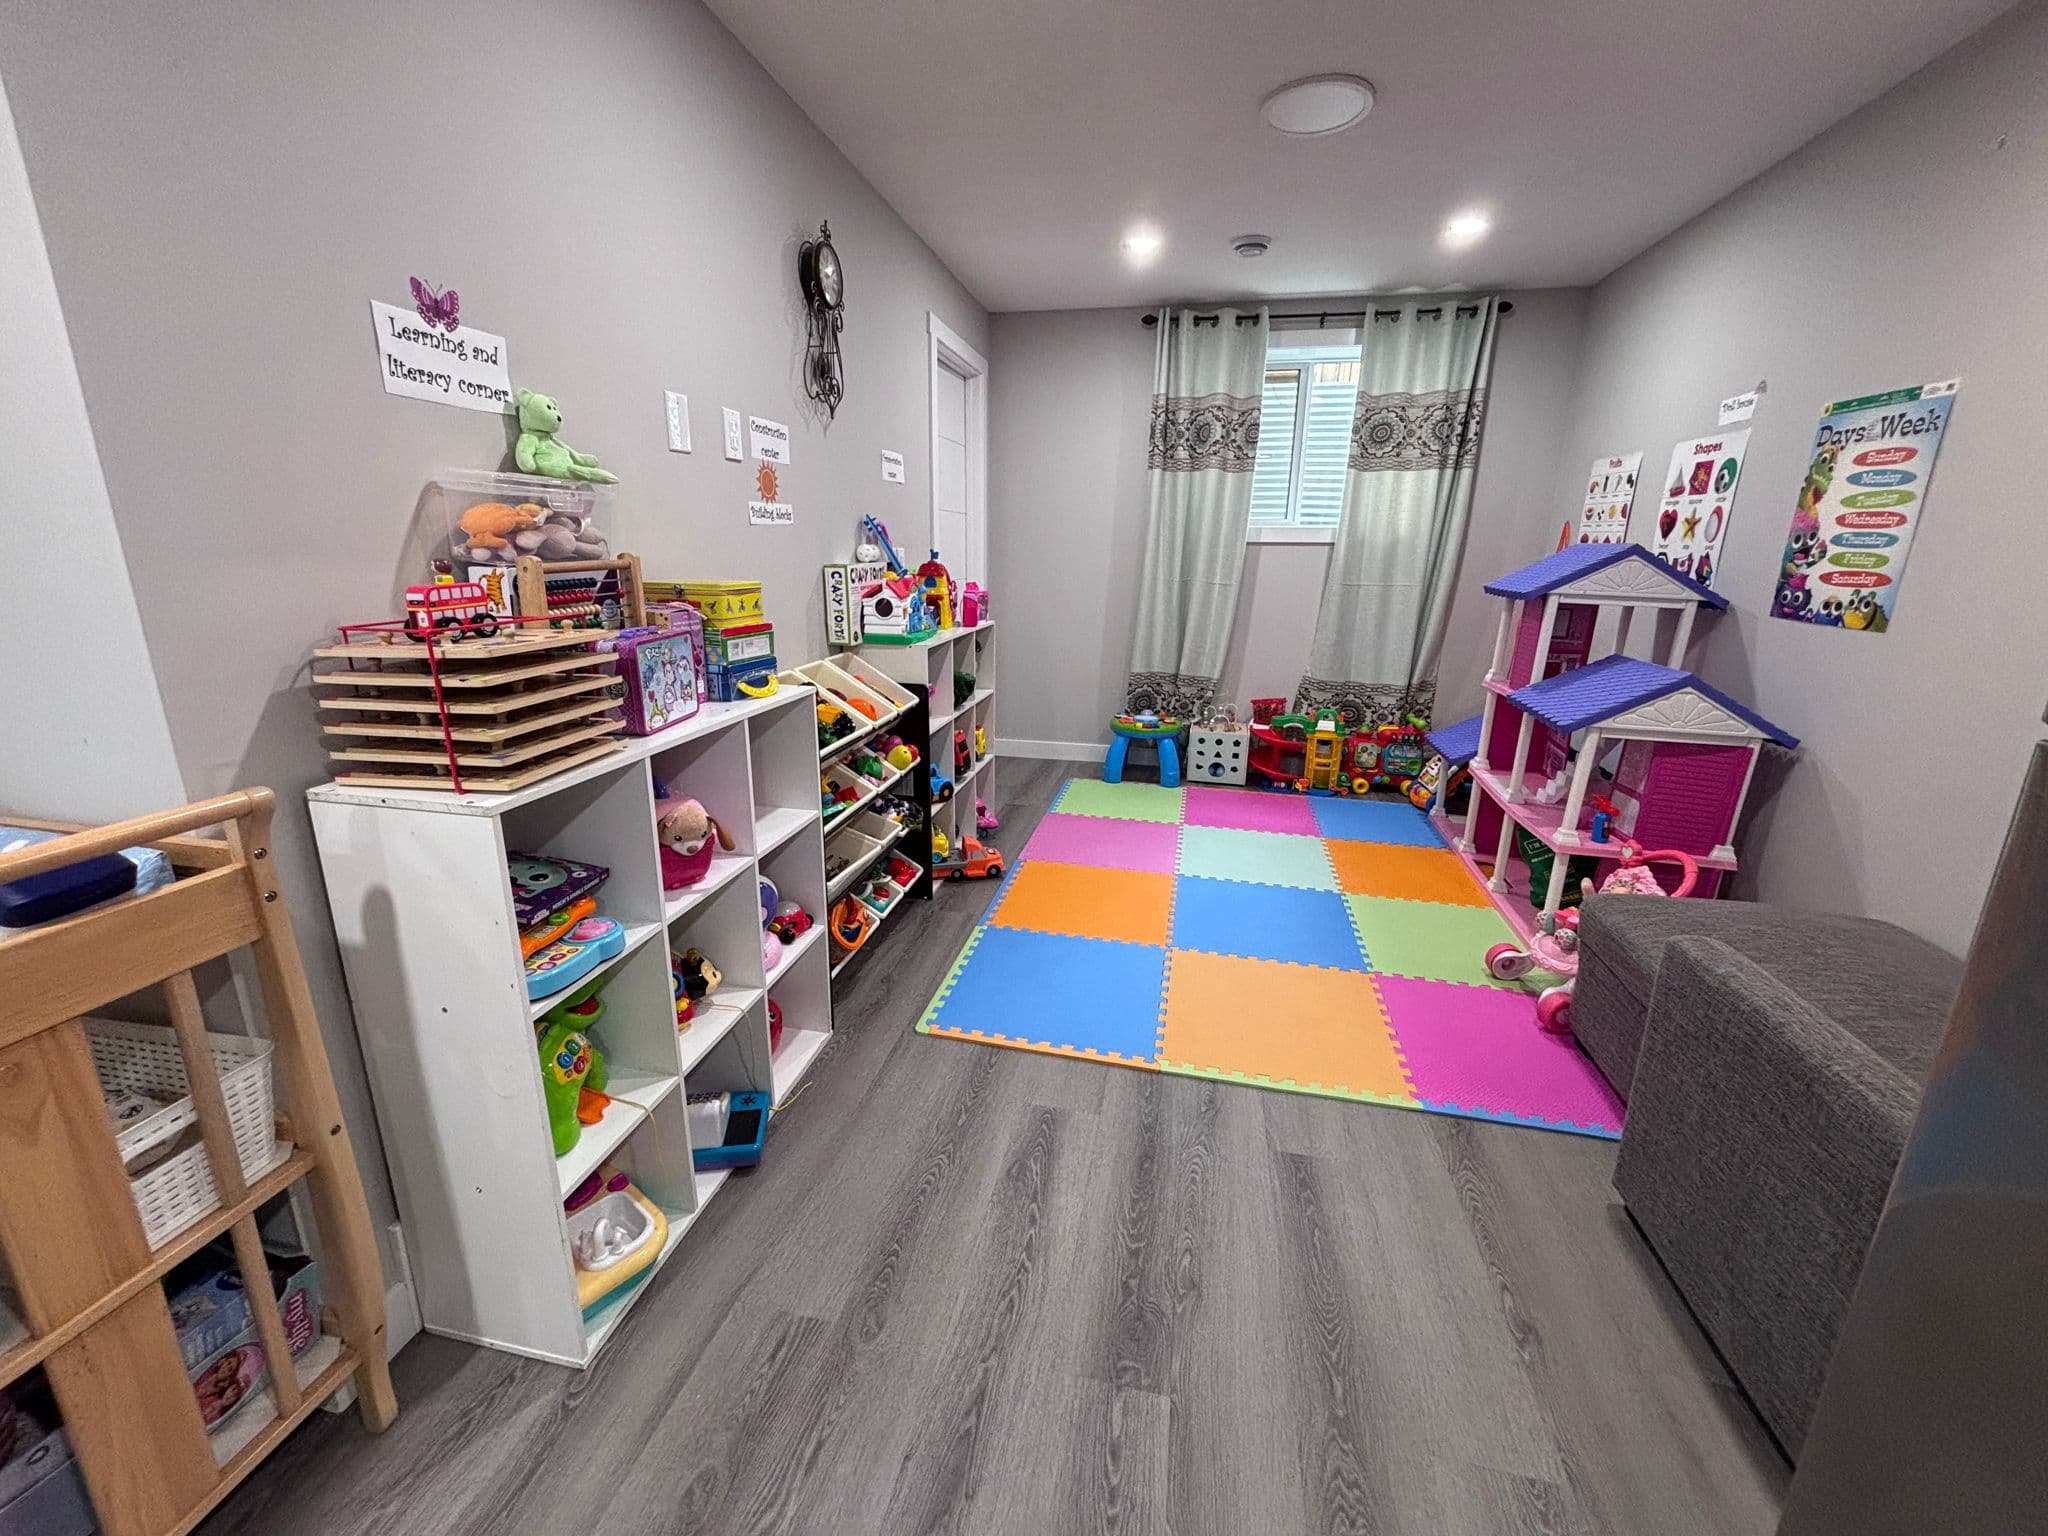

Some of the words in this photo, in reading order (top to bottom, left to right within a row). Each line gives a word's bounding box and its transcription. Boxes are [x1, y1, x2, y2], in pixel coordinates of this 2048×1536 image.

[388, 316, 468, 361] Learning
[473, 346, 498, 366] and
[387, 354, 451, 393] literacy
[458, 379, 509, 402] corner
[750, 420, 787, 440] Construction
[1816, 425, 1866, 450] Days
[1880, 408, 1942, 439] Week
[1693, 442, 1723, 455] Shapes
[1866, 449, 1908, 463] Sunday
[1860, 471, 1903, 485] Monday
[751, 505, 774, 522] Building
[775, 507, 792, 521] blocks
[1845, 513, 1900, 527] Wednesday
[1841, 533, 1889, 547] Thursday
[1843, 553, 1877, 567] Friday
[850, 567, 869, 584] CRAZY
[1831, 573, 1877, 587] Saturday
[830, 571, 843, 606] CRAZY
